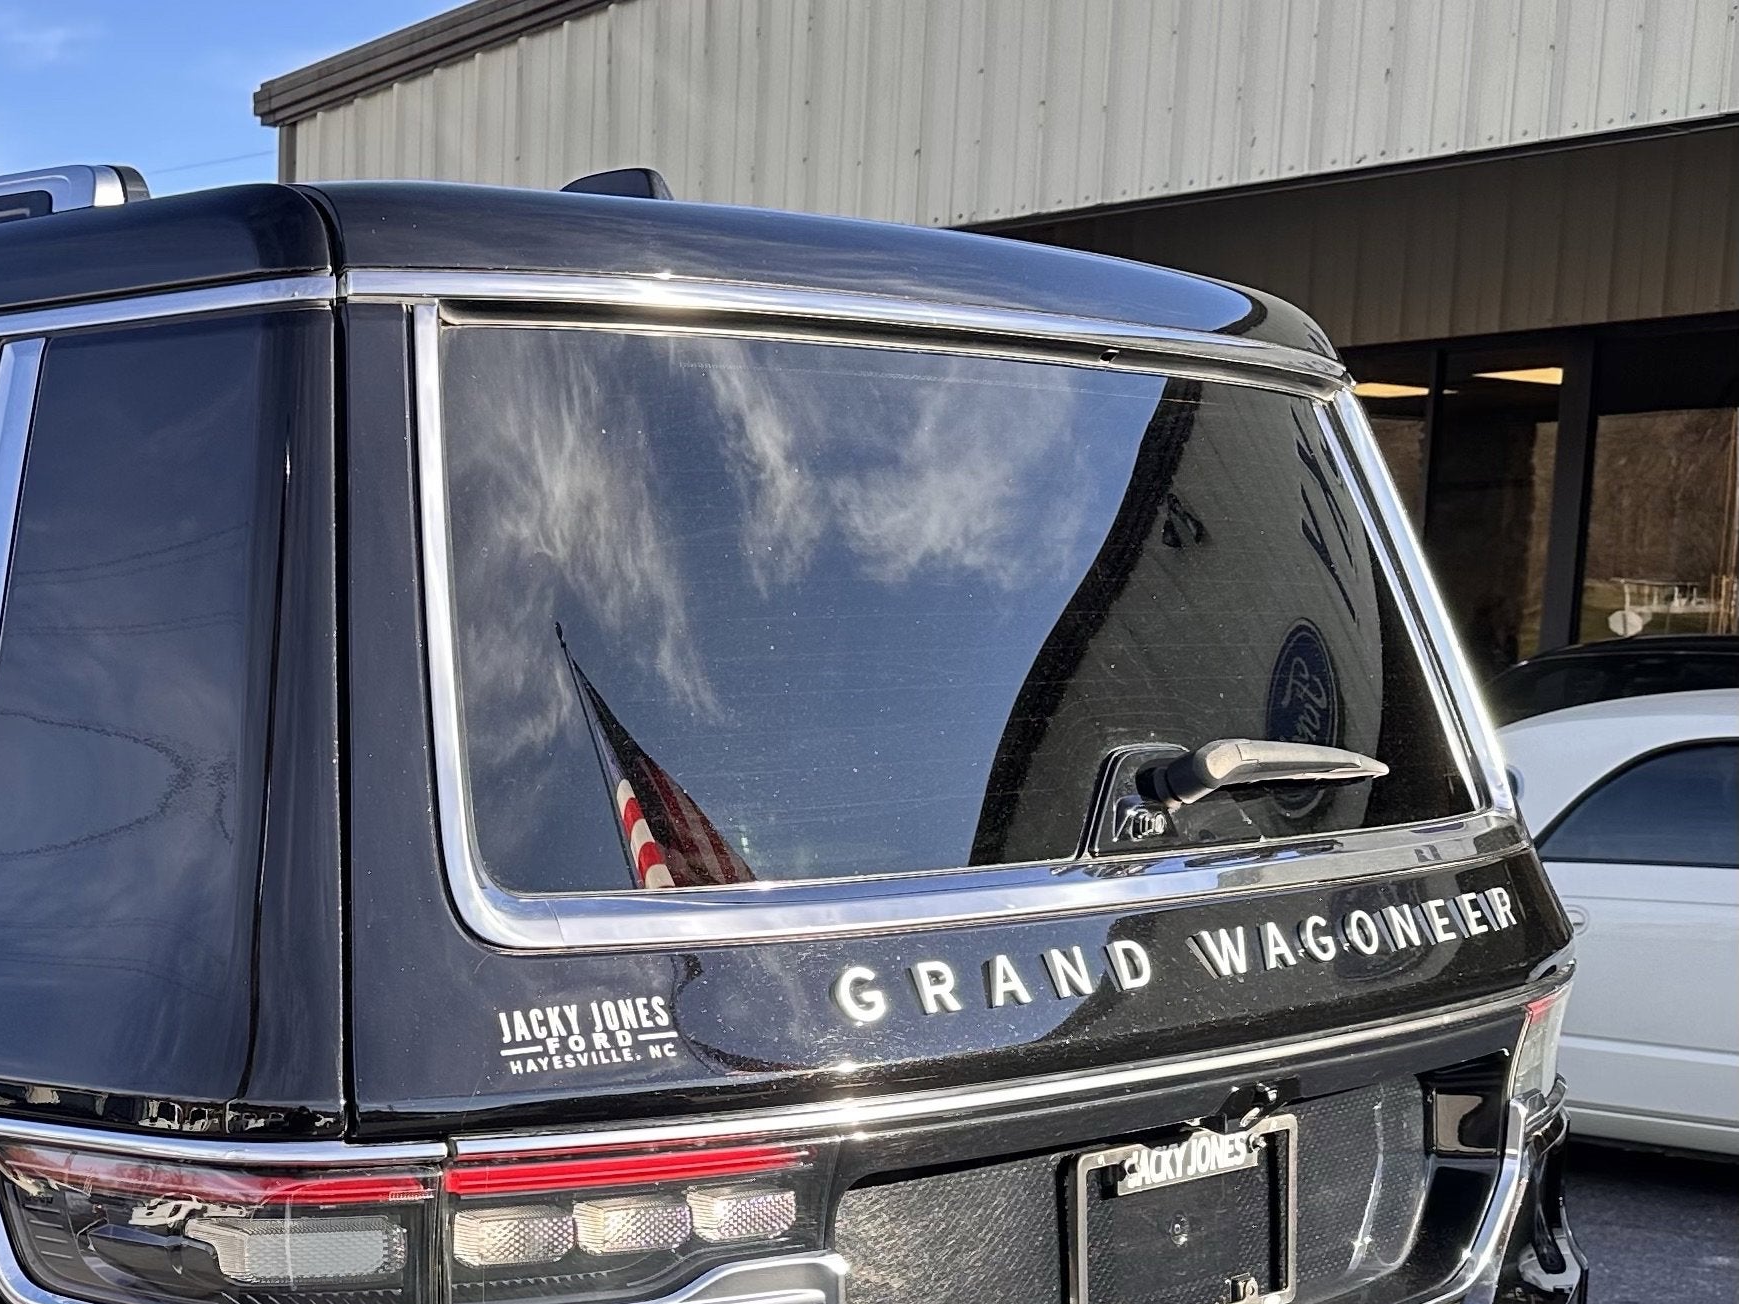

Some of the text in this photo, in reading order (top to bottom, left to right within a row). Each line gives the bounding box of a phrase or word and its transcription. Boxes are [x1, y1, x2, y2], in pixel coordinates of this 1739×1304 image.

[831, 887, 1517, 1026] GRAND WAGONEER
[498, 996, 669, 1044] JACKY JONES
[545, 1029, 633, 1055] FORD
[648, 1043, 677, 1059] NC
[1187, 1133, 1247, 1176] JONES
